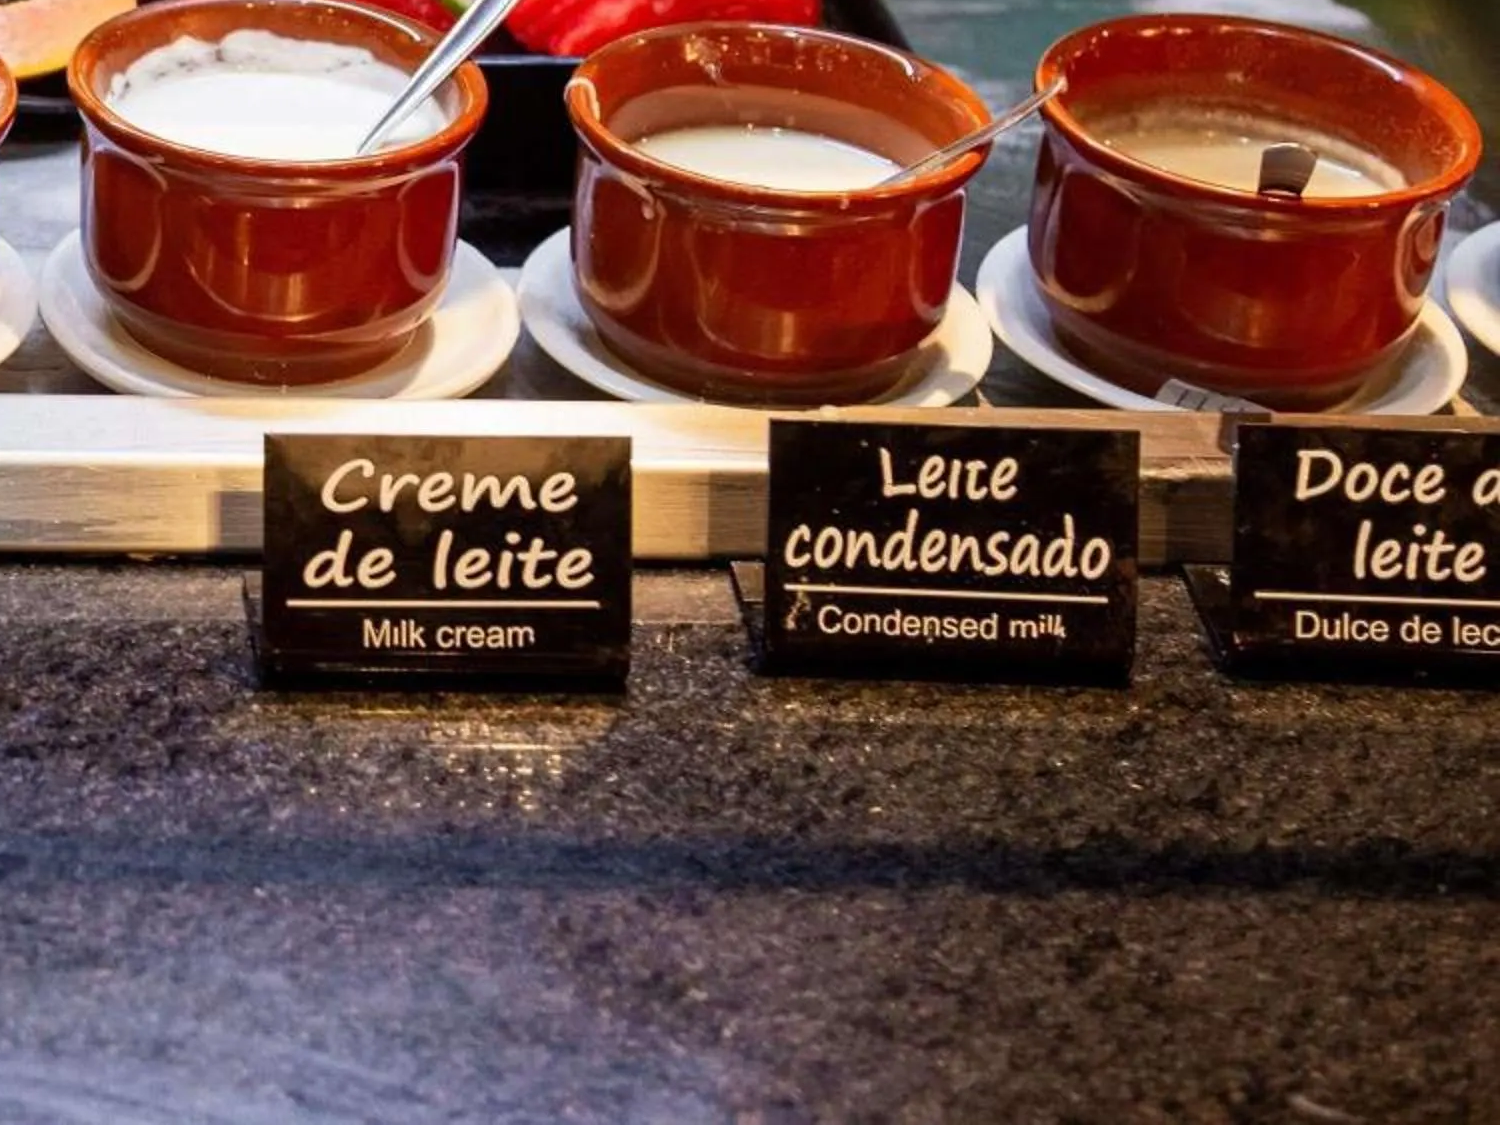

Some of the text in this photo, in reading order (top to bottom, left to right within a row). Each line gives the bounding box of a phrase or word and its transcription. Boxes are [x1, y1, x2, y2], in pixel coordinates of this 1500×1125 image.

[320, 458, 579, 513] Creme
[879, 446, 1019, 500] Leite
[1295, 449, 1446, 505] Doce
[302, 529, 595, 590] de leite
[783, 508, 1112, 580] condensado
[1352, 519, 1487, 582] leite
[362, 618, 535, 649] Milk cream
[817, 605, 999, 640] Condensed
[1294, 610, 1390, 641] Dulce
[1400, 614, 1443, 644] de
